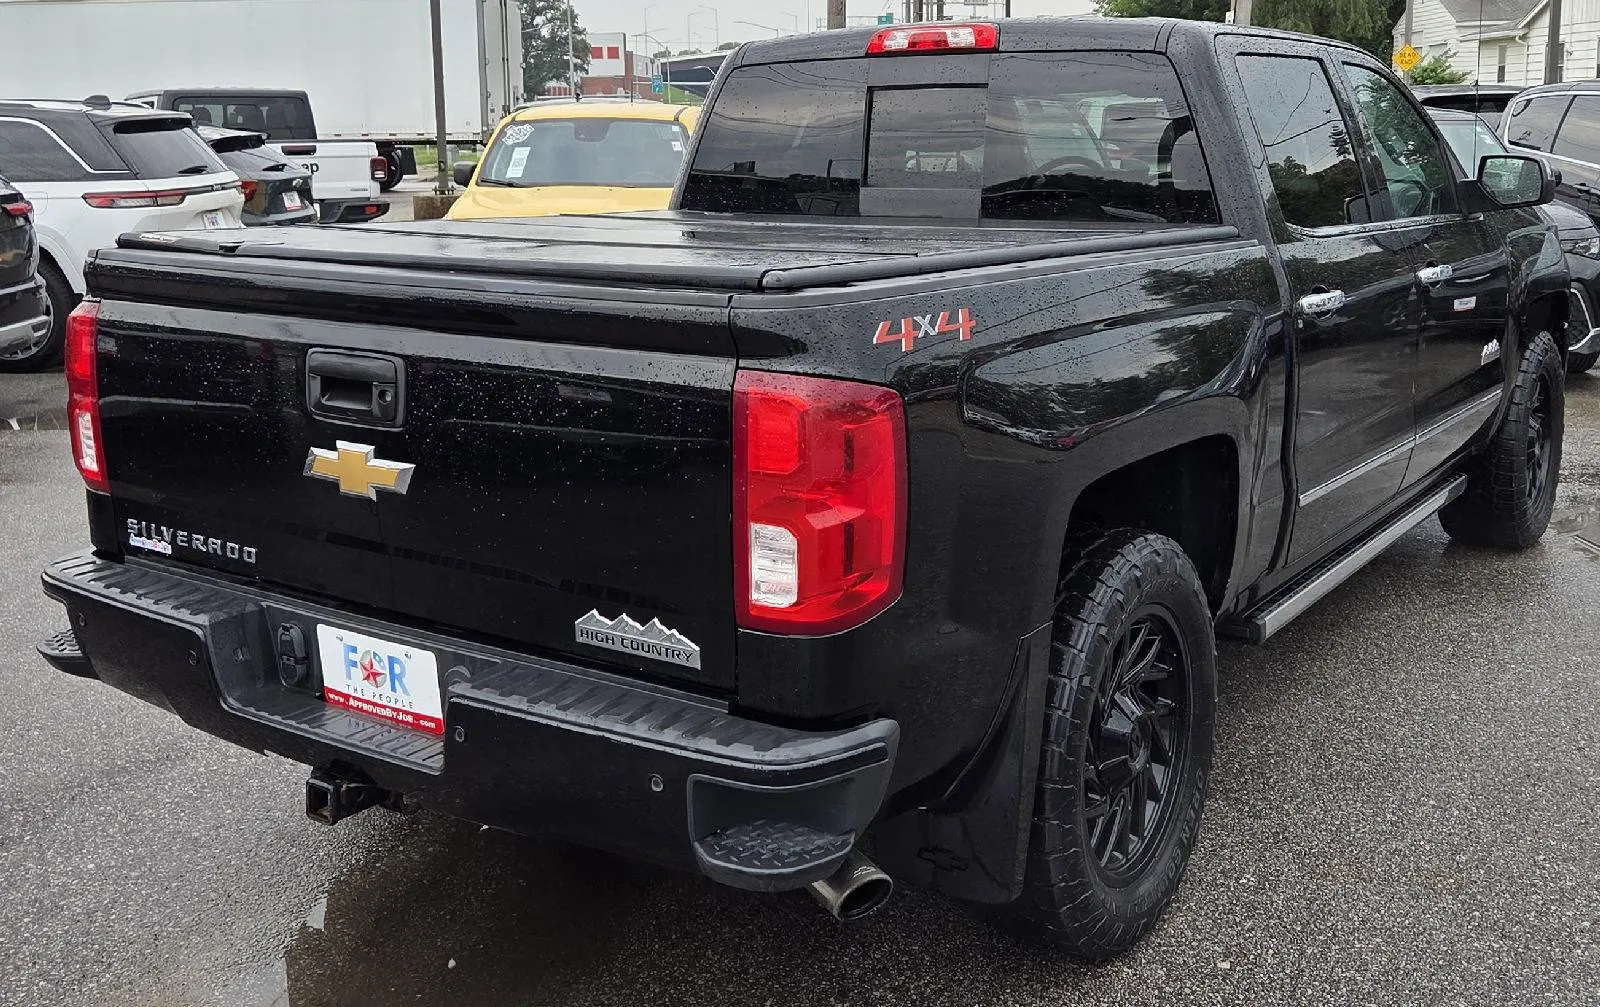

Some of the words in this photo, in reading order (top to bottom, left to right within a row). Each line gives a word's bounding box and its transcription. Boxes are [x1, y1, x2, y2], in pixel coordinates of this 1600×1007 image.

[873, 307, 977, 352] 4x4
[127, 518, 257, 563] SILVERADO
[579, 628, 615, 646] HIGH
[620, 638, 693, 662] COUNTRY
[346, 683, 365, 697] THE
[372, 691, 413, 709] PEOPLE
